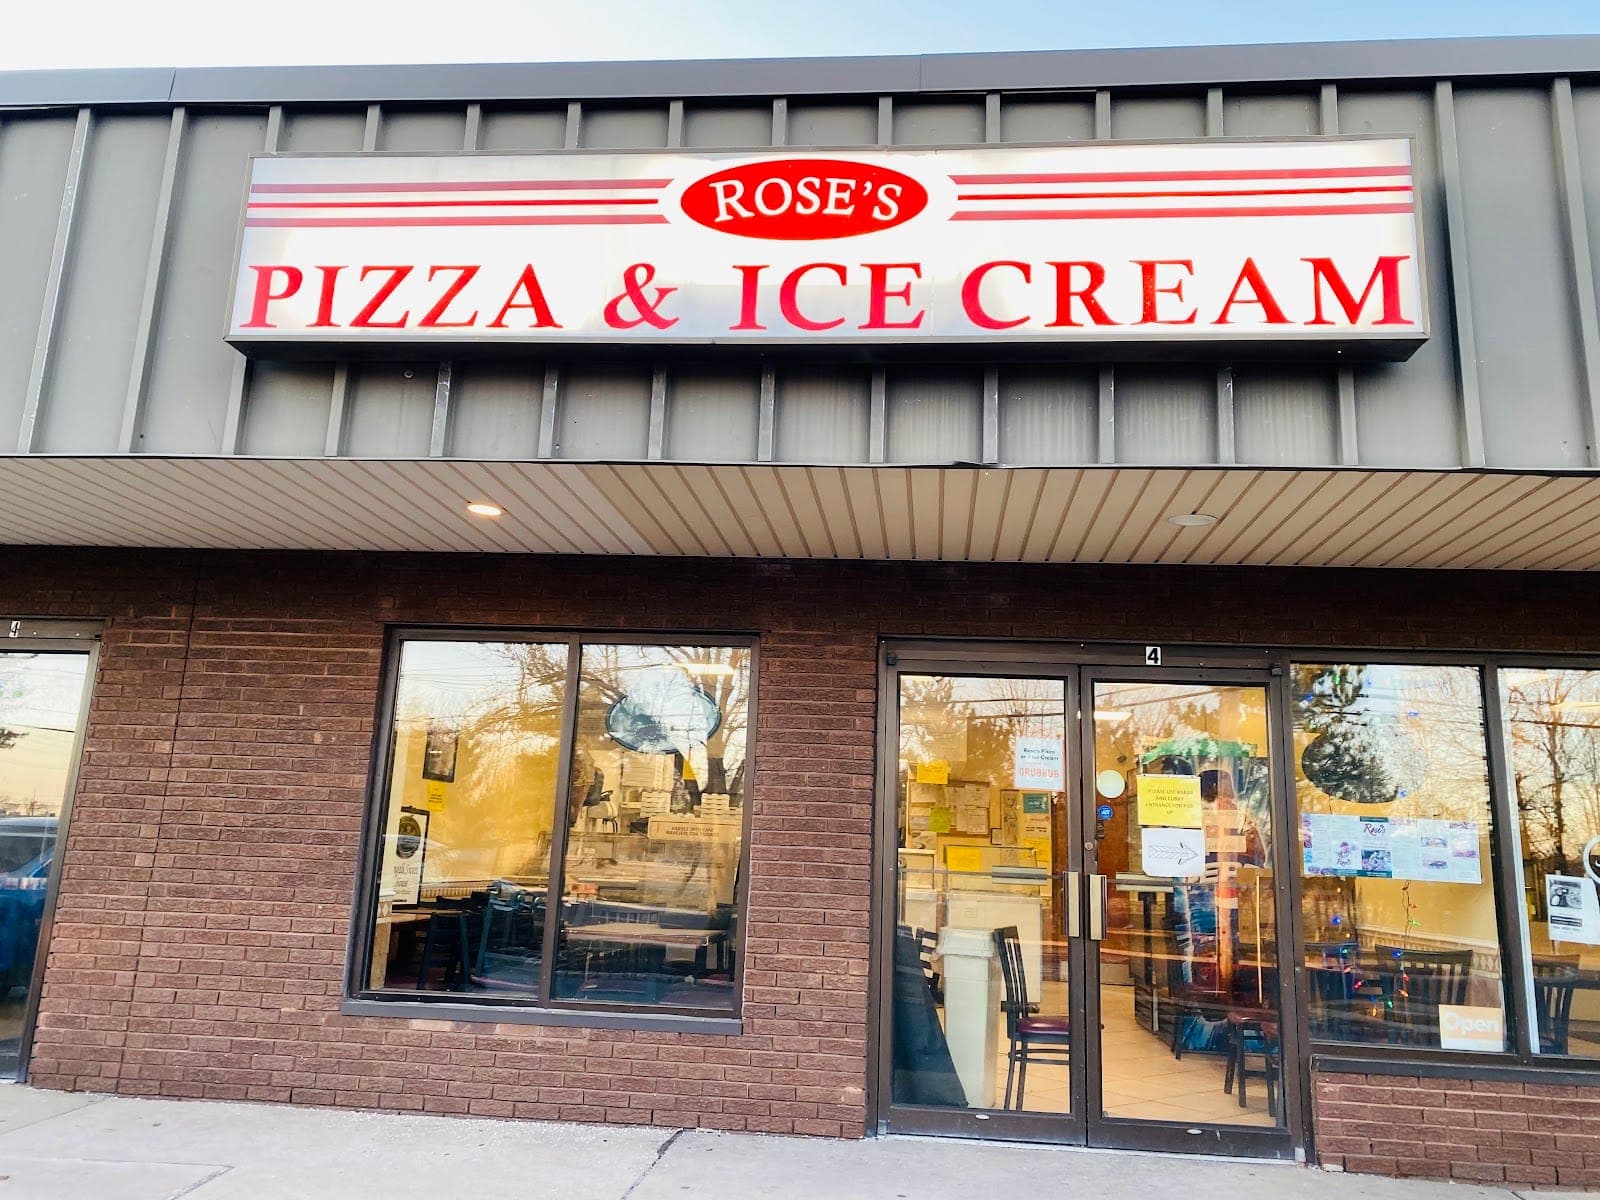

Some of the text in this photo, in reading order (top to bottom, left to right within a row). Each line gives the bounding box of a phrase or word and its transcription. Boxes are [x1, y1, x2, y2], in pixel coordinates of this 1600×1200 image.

[709, 176, 902, 222] ROSE'S
[240, 255, 1415, 331] PIZZA & ICE CREAM
[1147, 647, 1160, 664] 4
[1019, 767, 1060, 778] GRUBHUB
[1443, 1011, 1499, 1034] Open
